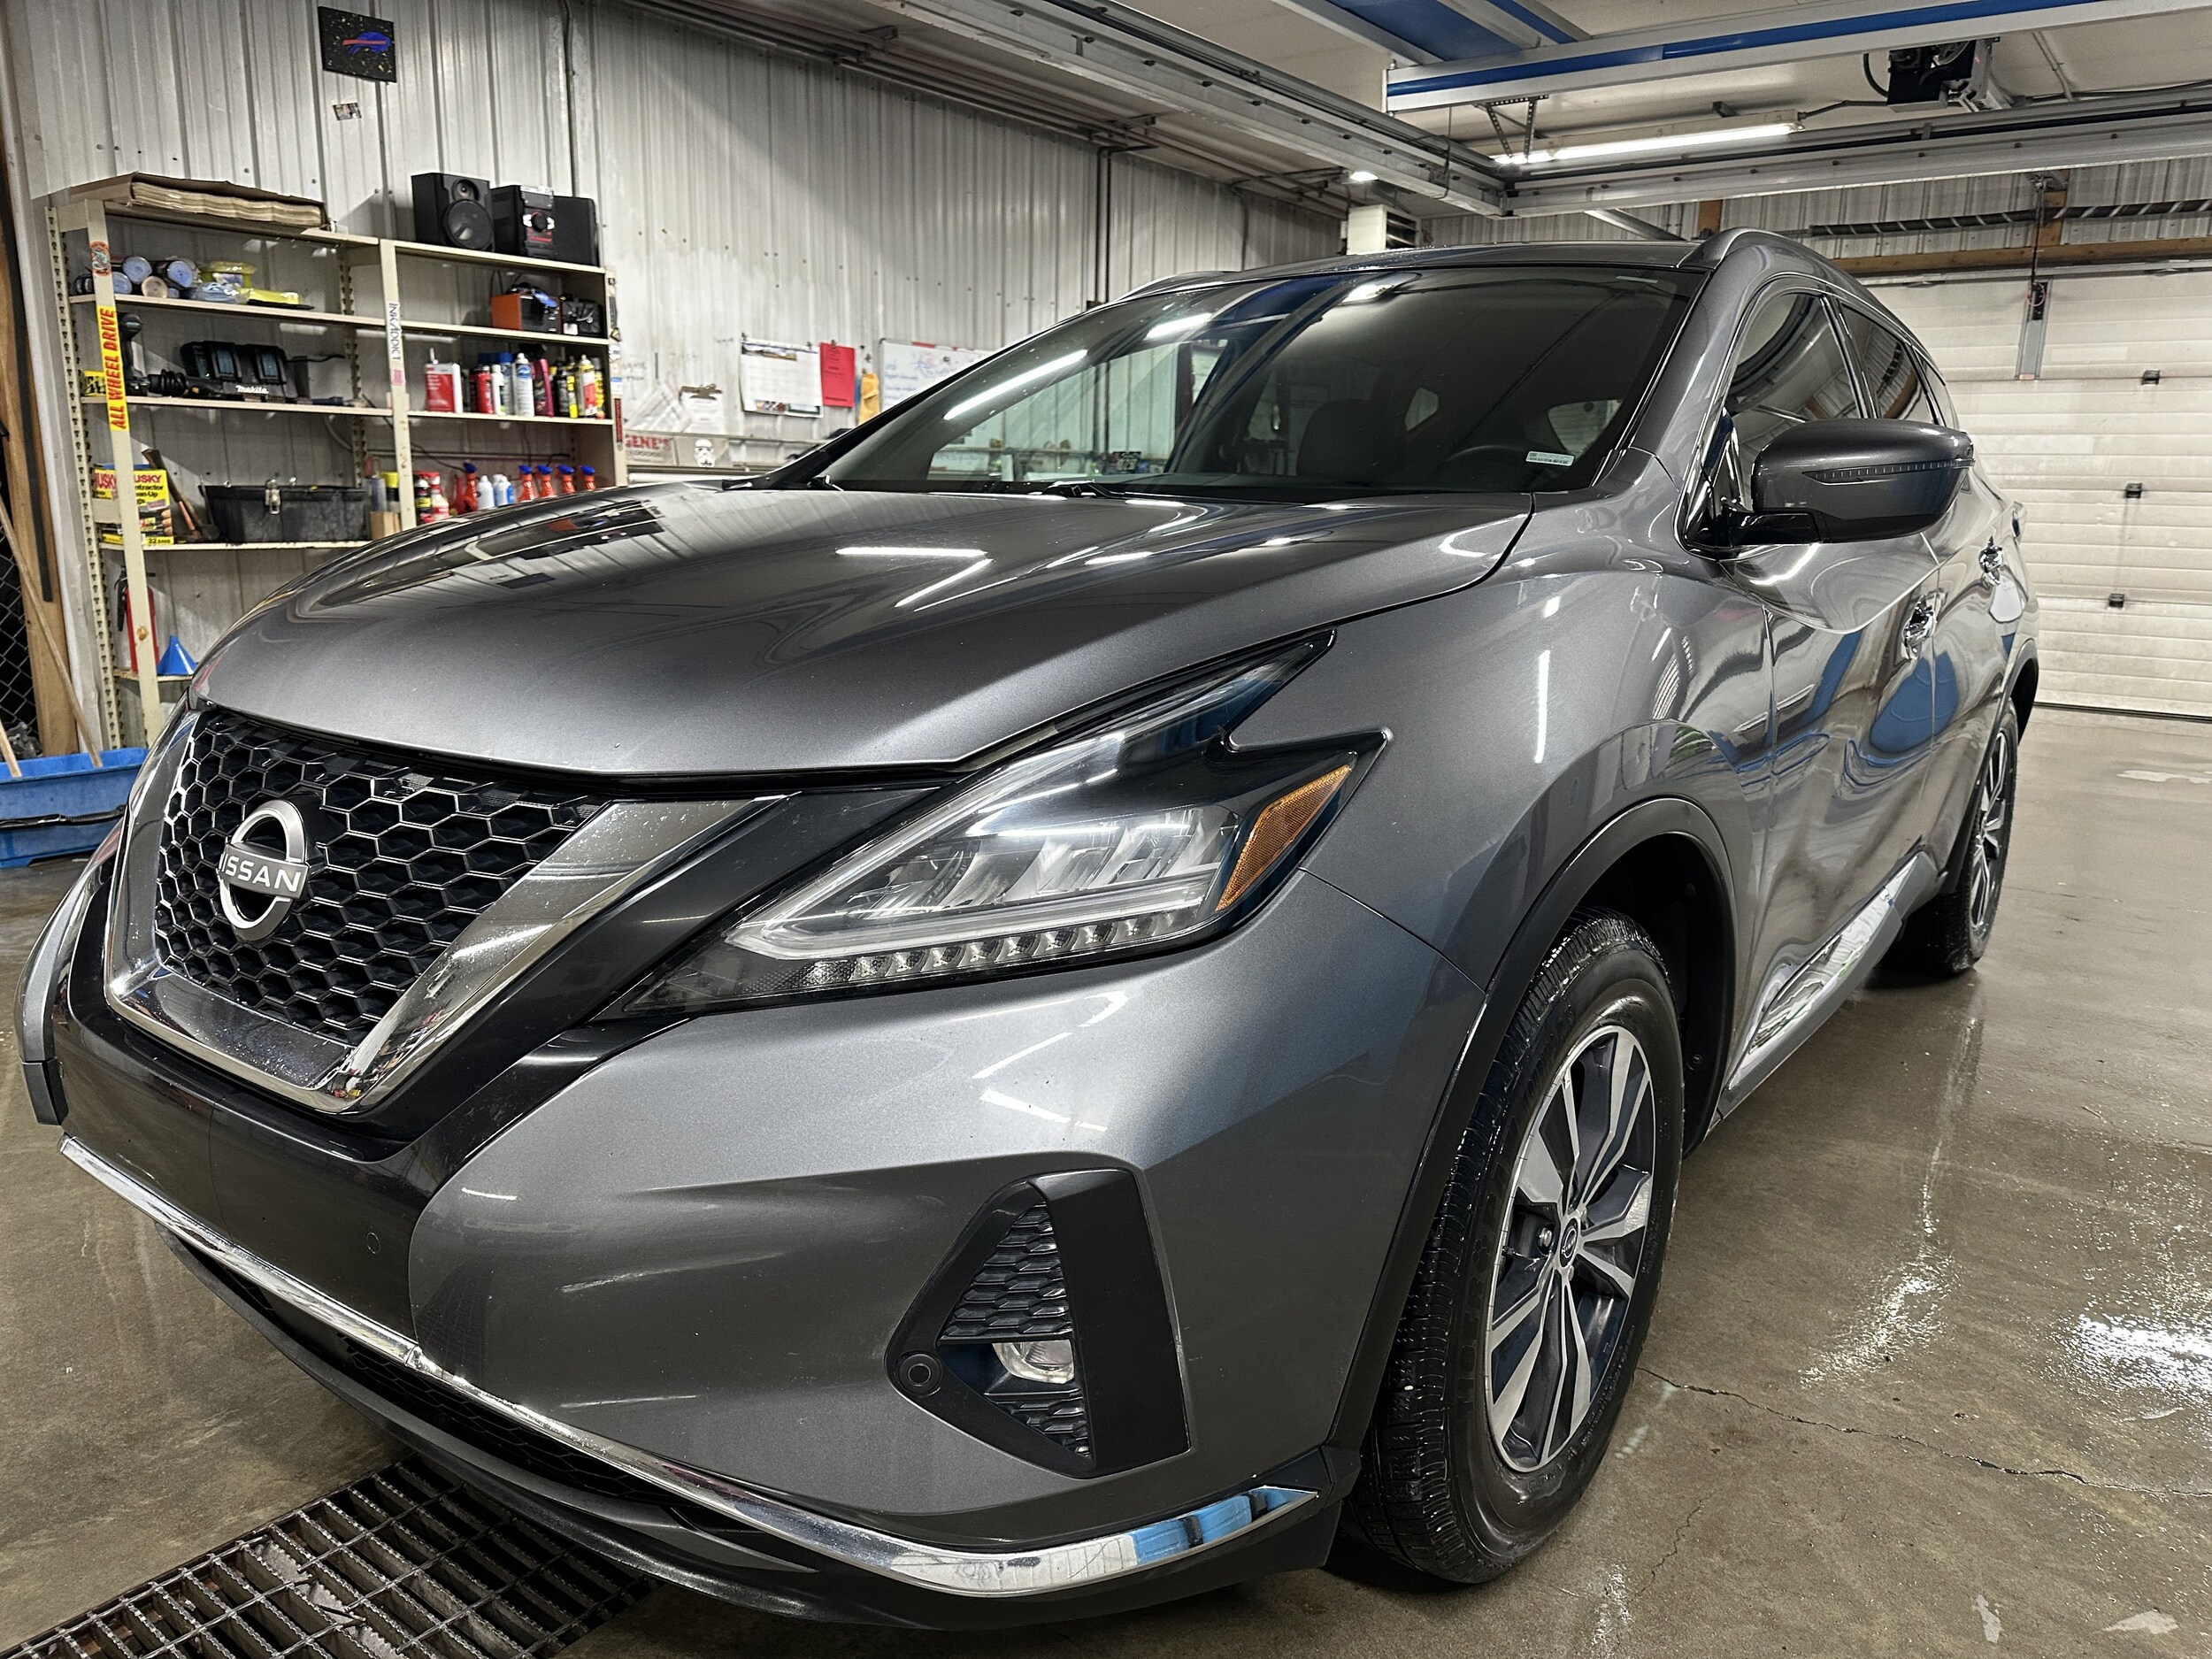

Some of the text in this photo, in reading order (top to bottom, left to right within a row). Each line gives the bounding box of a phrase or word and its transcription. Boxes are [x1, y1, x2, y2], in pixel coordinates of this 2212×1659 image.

[99, 308, 127, 430] ALL WHEEL DRIVE
[134, 474, 161, 483] USKY
